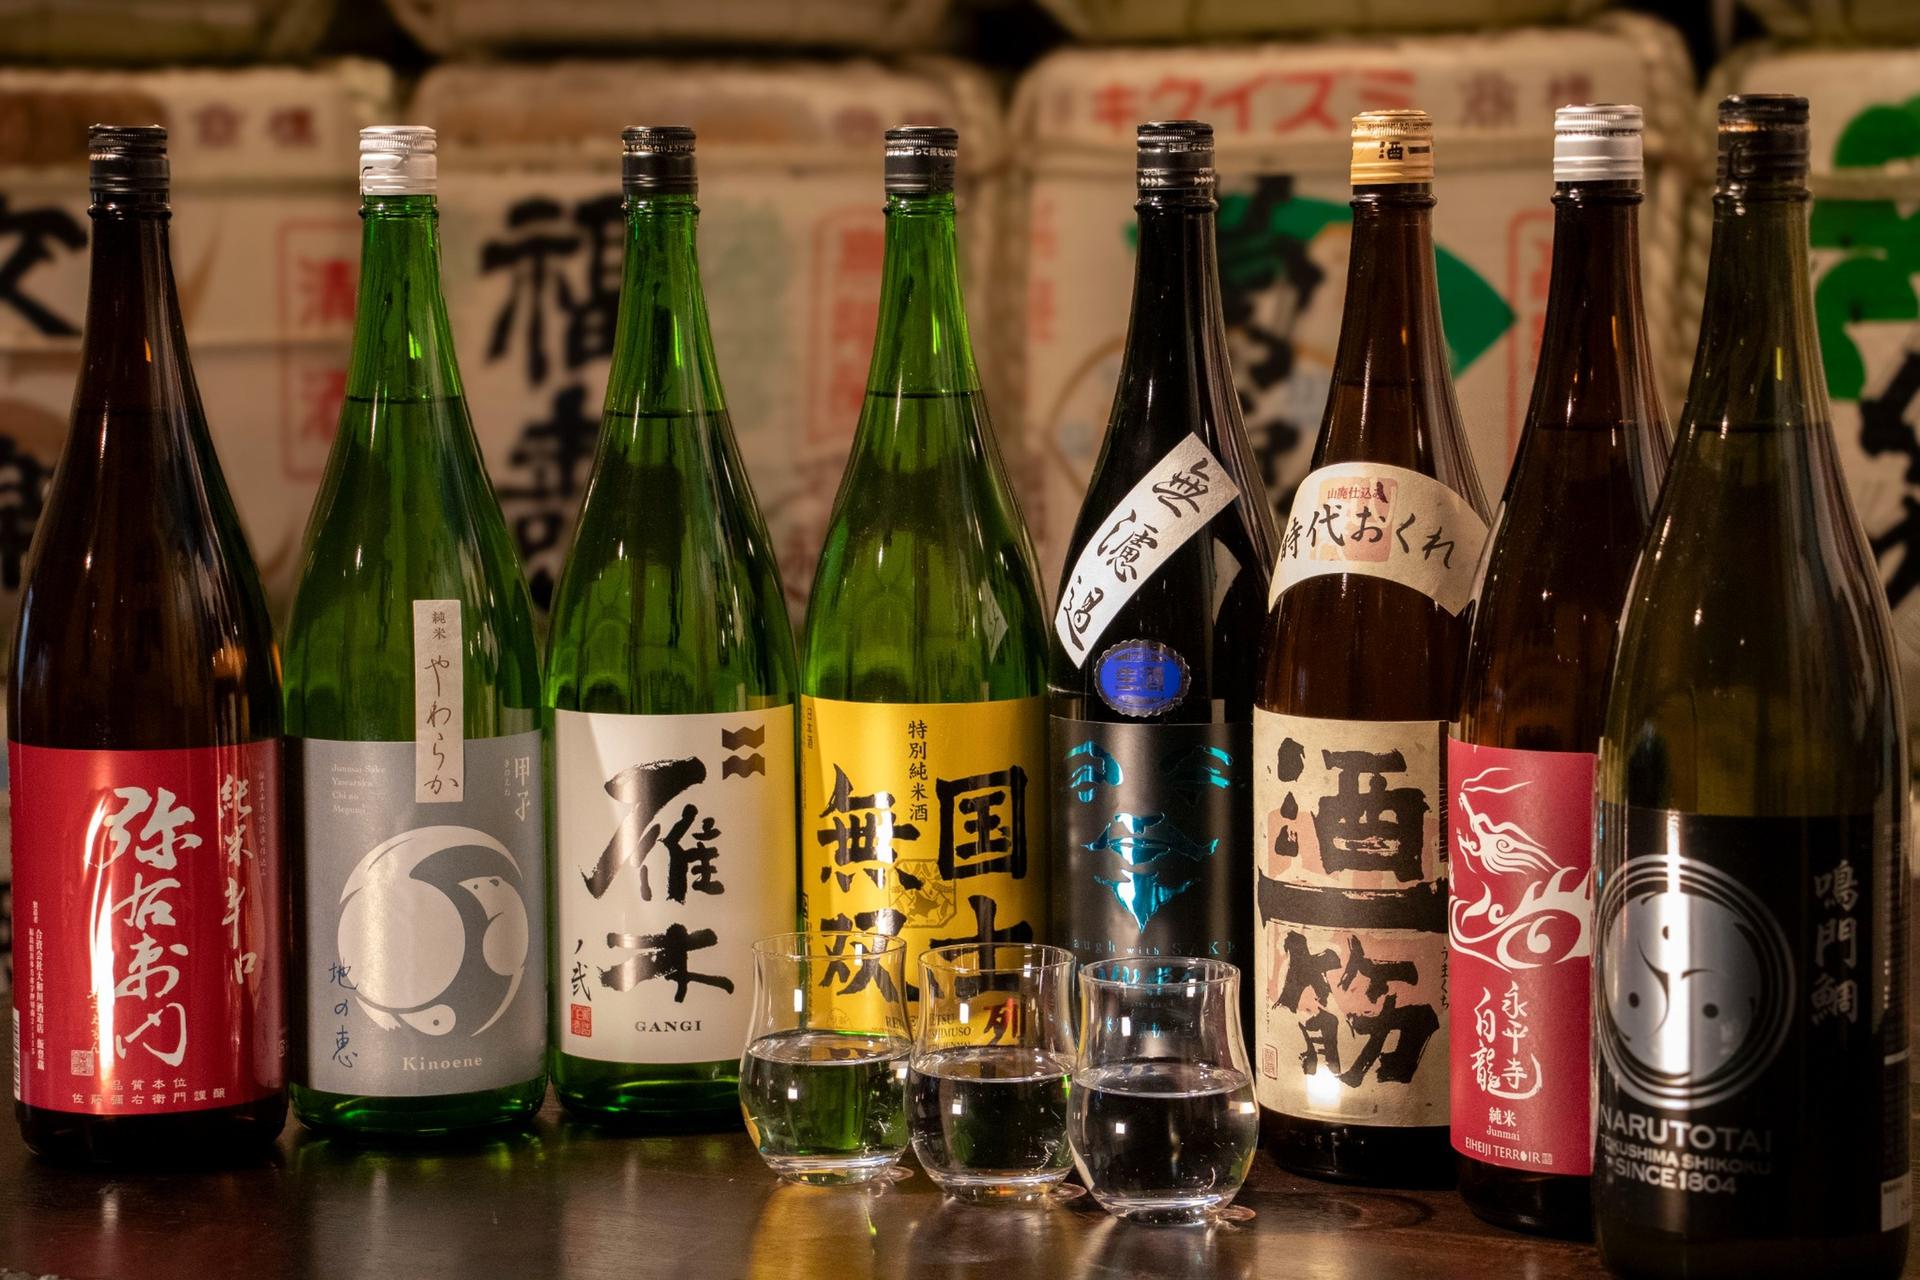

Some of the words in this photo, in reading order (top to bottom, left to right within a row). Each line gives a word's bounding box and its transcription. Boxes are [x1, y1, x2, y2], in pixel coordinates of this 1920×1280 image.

[1281, 504, 1455, 569] 時代おくれ
[432, 611, 446, 640] 純米
[424, 655, 459, 794] やわらか
[909, 720, 928, 822] 特別純米酒
[579, 756, 734, 1004] 雁木
[1811, 859, 1860, 1026] 鳴門鯛
[1441, 946, 1449, 1010] うまくち
[634, 1020, 703, 1033] GANGI
[1502, 980, 1529, 1089] 永平寺
[402, 1056, 483, 1072] Kinoene
[1486, 1125, 1520, 1142] Junmai
[1488, 1106, 1517, 1128] 純米
[1600, 1102, 1773, 1154] NARUTOTAI
[1465, 1136, 1492, 1157] EIHEIJI
[1493, 1144, 1541, 1165] TERROIR
